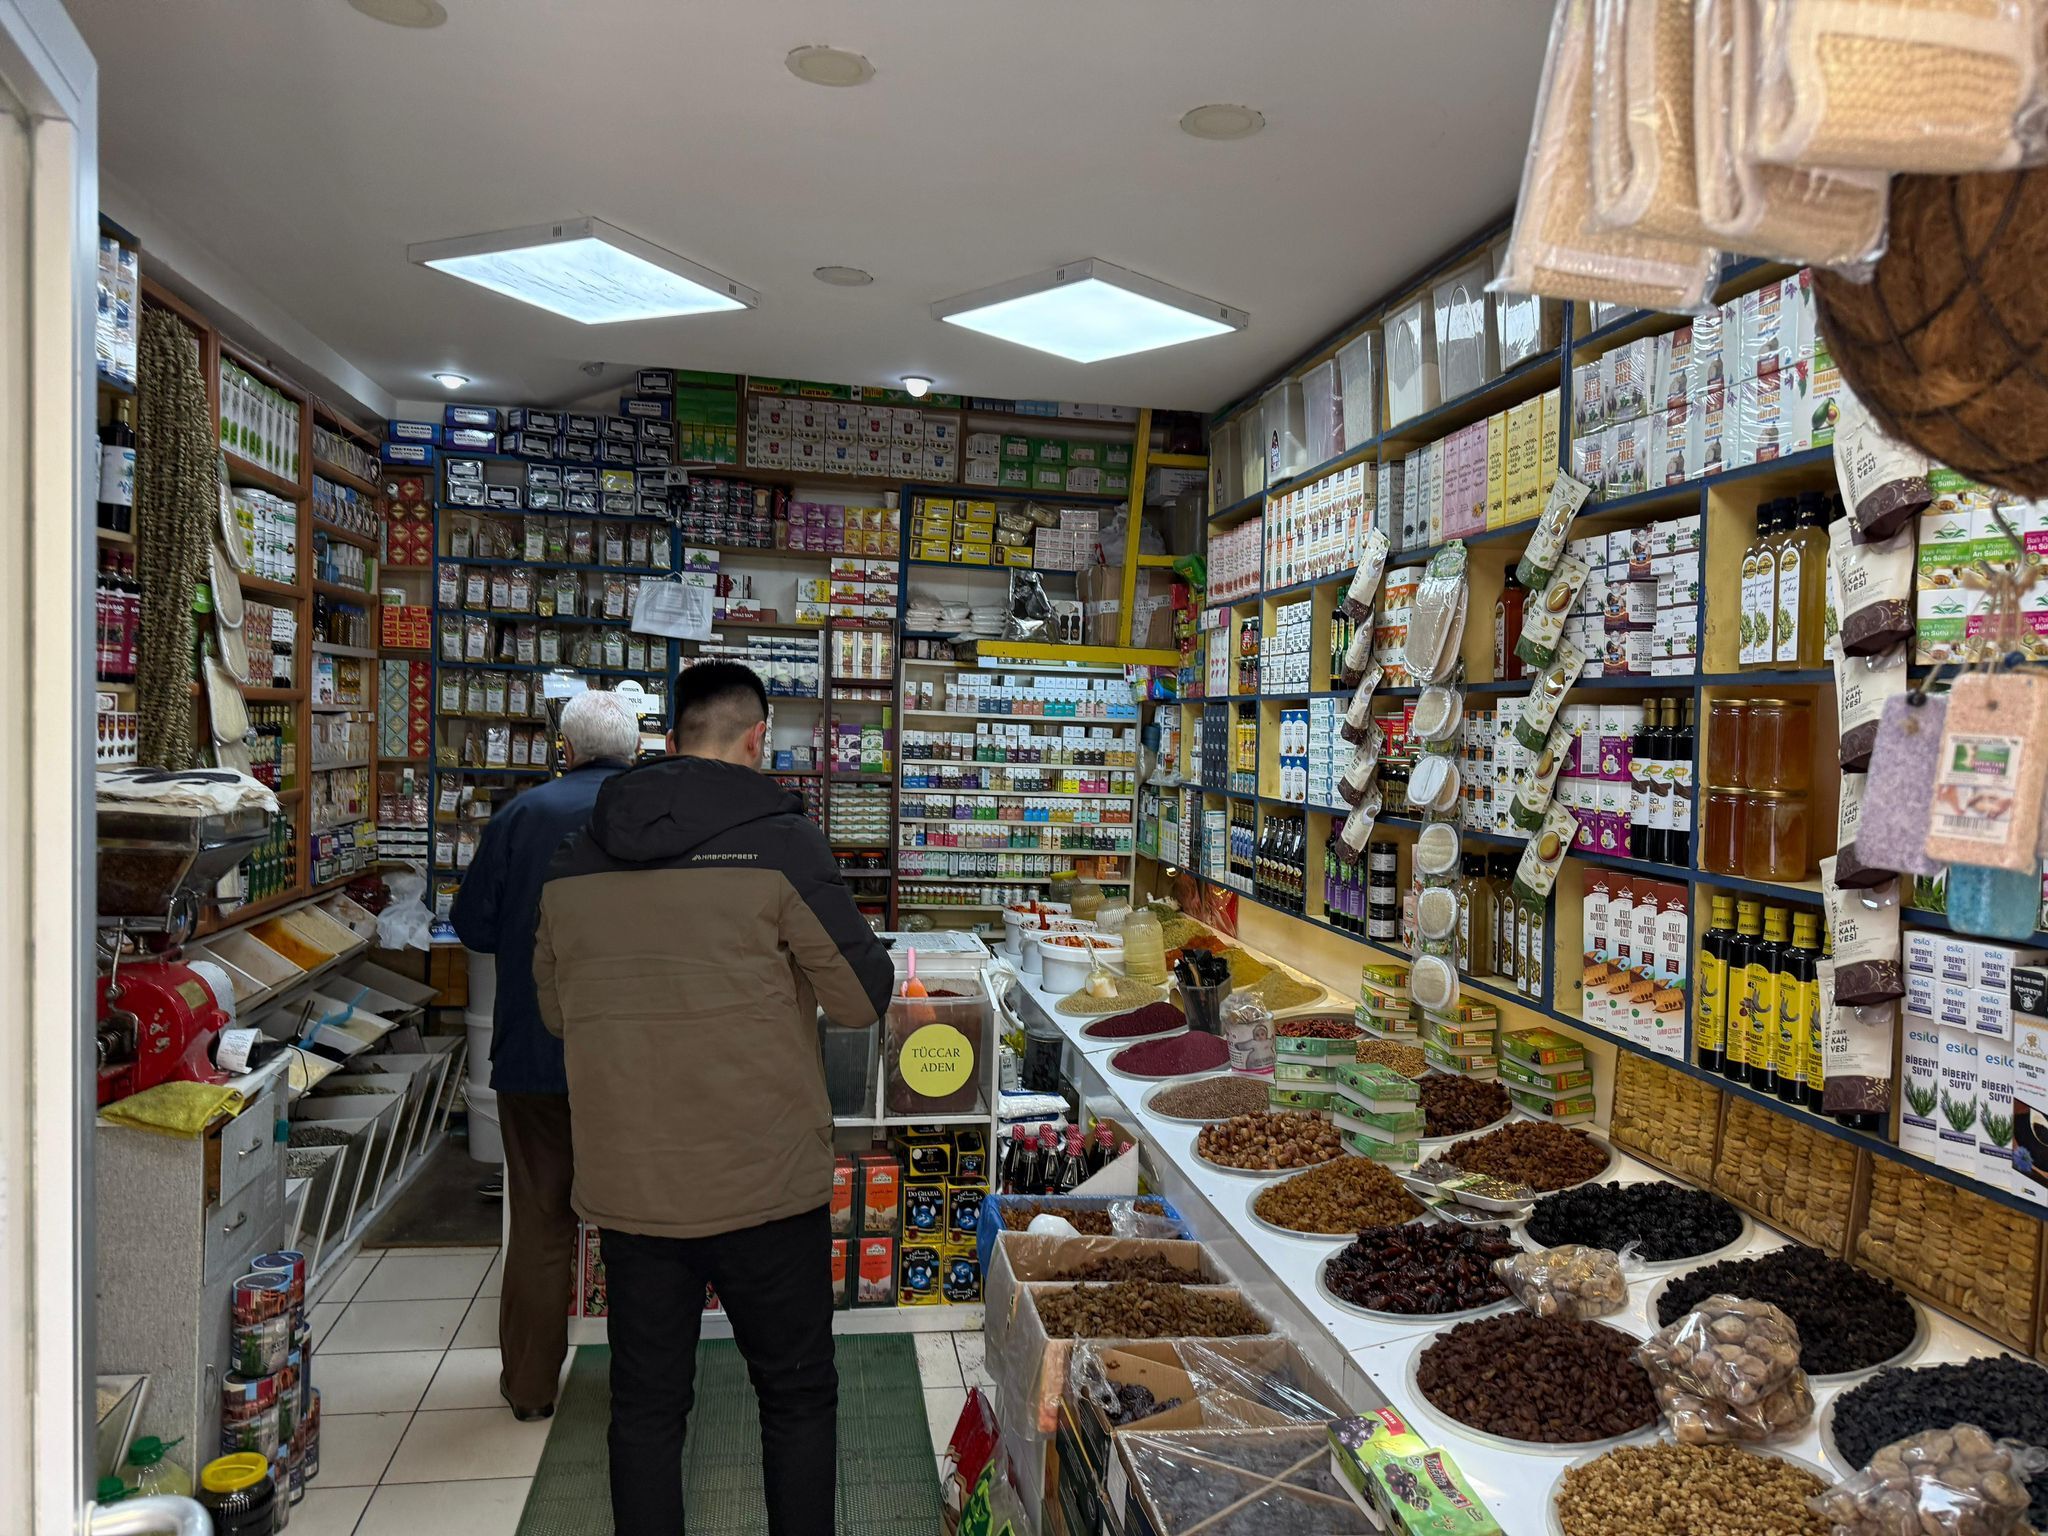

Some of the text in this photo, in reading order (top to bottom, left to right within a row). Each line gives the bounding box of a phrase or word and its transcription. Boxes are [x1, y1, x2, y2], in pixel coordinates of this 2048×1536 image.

[1848, 571, 1868, 584] KAH-
[1848, 578, 1867, 592] VESİ
[1839, 925, 1859, 935] KAH-
[1838, 931, 1857, 943] VESİ
[1913, 937, 1930, 946] esila
[1946, 944, 1963, 954] esila
[1914, 955, 1928, 963] SUYU
[1984, 951, 2002, 960] esila
[1947, 963, 1961, 971] SUYU
[1986, 970, 2000, 978] SUYU
[1912, 979, 1929, 988] esila
[1946, 987, 1963, 997] esila
[1912, 996, 1926, 1005] SUYU
[1981, 995, 1999, 1005] esila
[1947, 1006, 1960, 1015] SUYU
[1982, 1015, 1996, 1023] SUYU
[1831, 1036, 1850, 1044] KAH-
[1909, 1031, 1938, 1044] esila
[912, 1046, 960, 1058] TÜCCAR
[1831, 1044, 1847, 1053] VESİ
[1946, 1043, 1978, 1056] esila
[920, 1062, 955, 1072] ADEM
[1905, 1055, 1938, 1069] BİBERİY
[1912, 1066, 1933, 1077] SUYU
[1942, 1067, 1978, 1082] BİBERİY
[1949, 1079, 1972, 1091] SUYU
[1981, 1079, 2014, 1095] BİBERİY
[1989, 1091, 2012, 1104] SUYU
